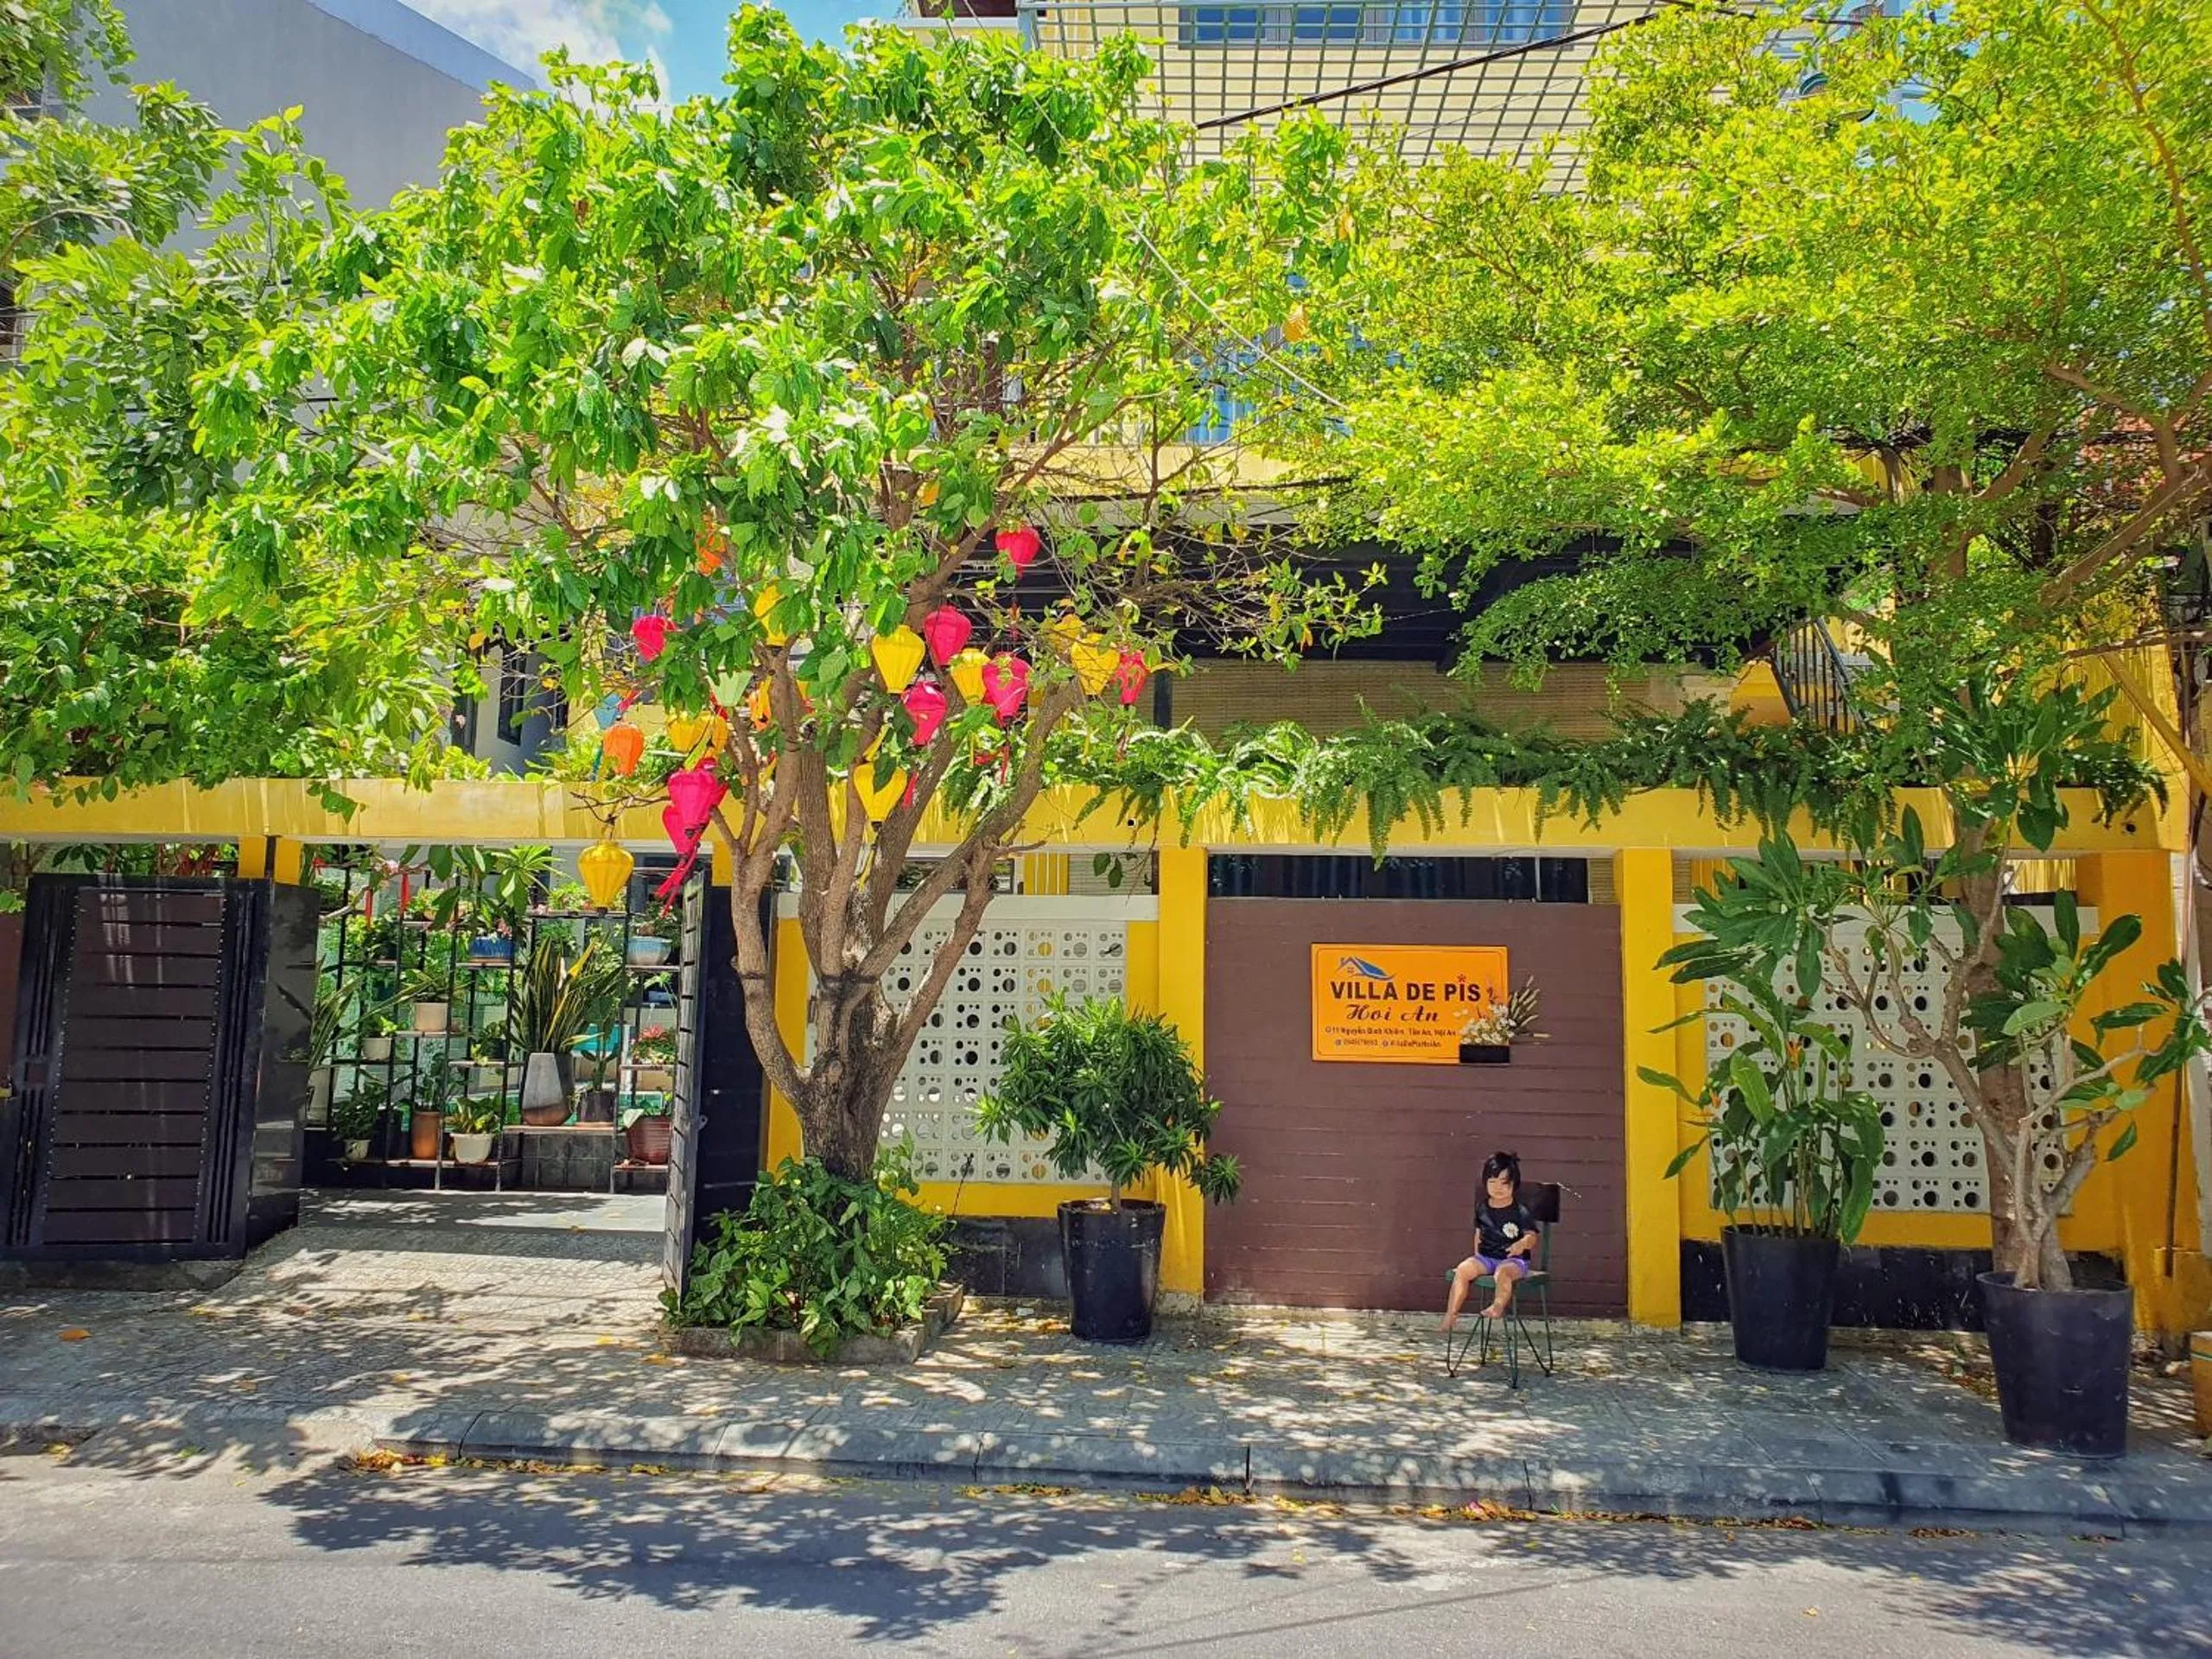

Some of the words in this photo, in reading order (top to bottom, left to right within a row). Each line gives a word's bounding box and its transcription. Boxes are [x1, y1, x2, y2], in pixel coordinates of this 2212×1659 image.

[1331, 982, 1398, 1001] VILLA
[1406, 982, 1435, 1001] DE
[1346, 1003, 1391, 1021] Hoi
[1401, 1005, 1439, 1021] An
